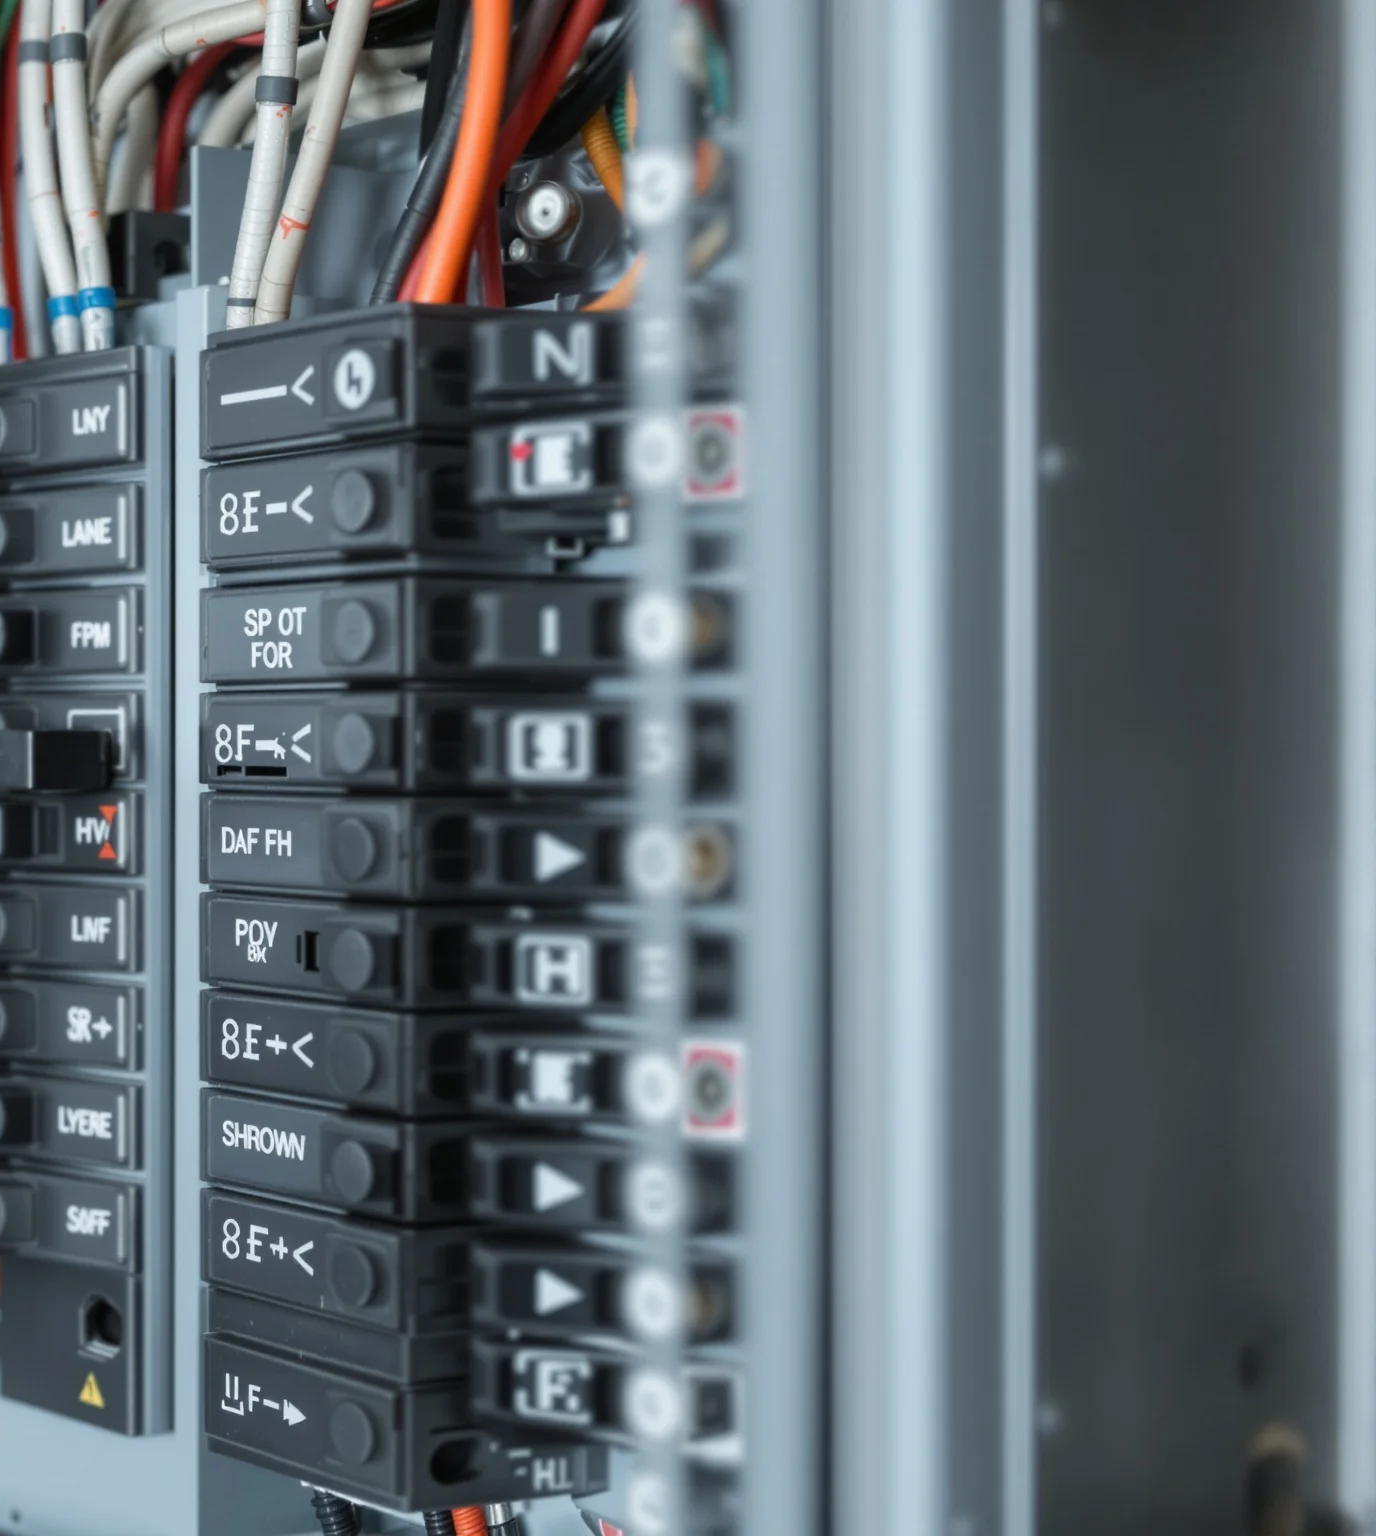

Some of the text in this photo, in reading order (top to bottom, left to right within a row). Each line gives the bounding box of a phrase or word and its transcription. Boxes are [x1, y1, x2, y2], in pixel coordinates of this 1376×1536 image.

[61, 517, 112, 547] LANE
[70, 622, 111, 649] FPM
[250, 641, 293, 669] FOR
[221, 826, 293, 858] DAF FH
[235, 918, 278, 948] POV
[222, 1120, 306, 1161] SHROWN
